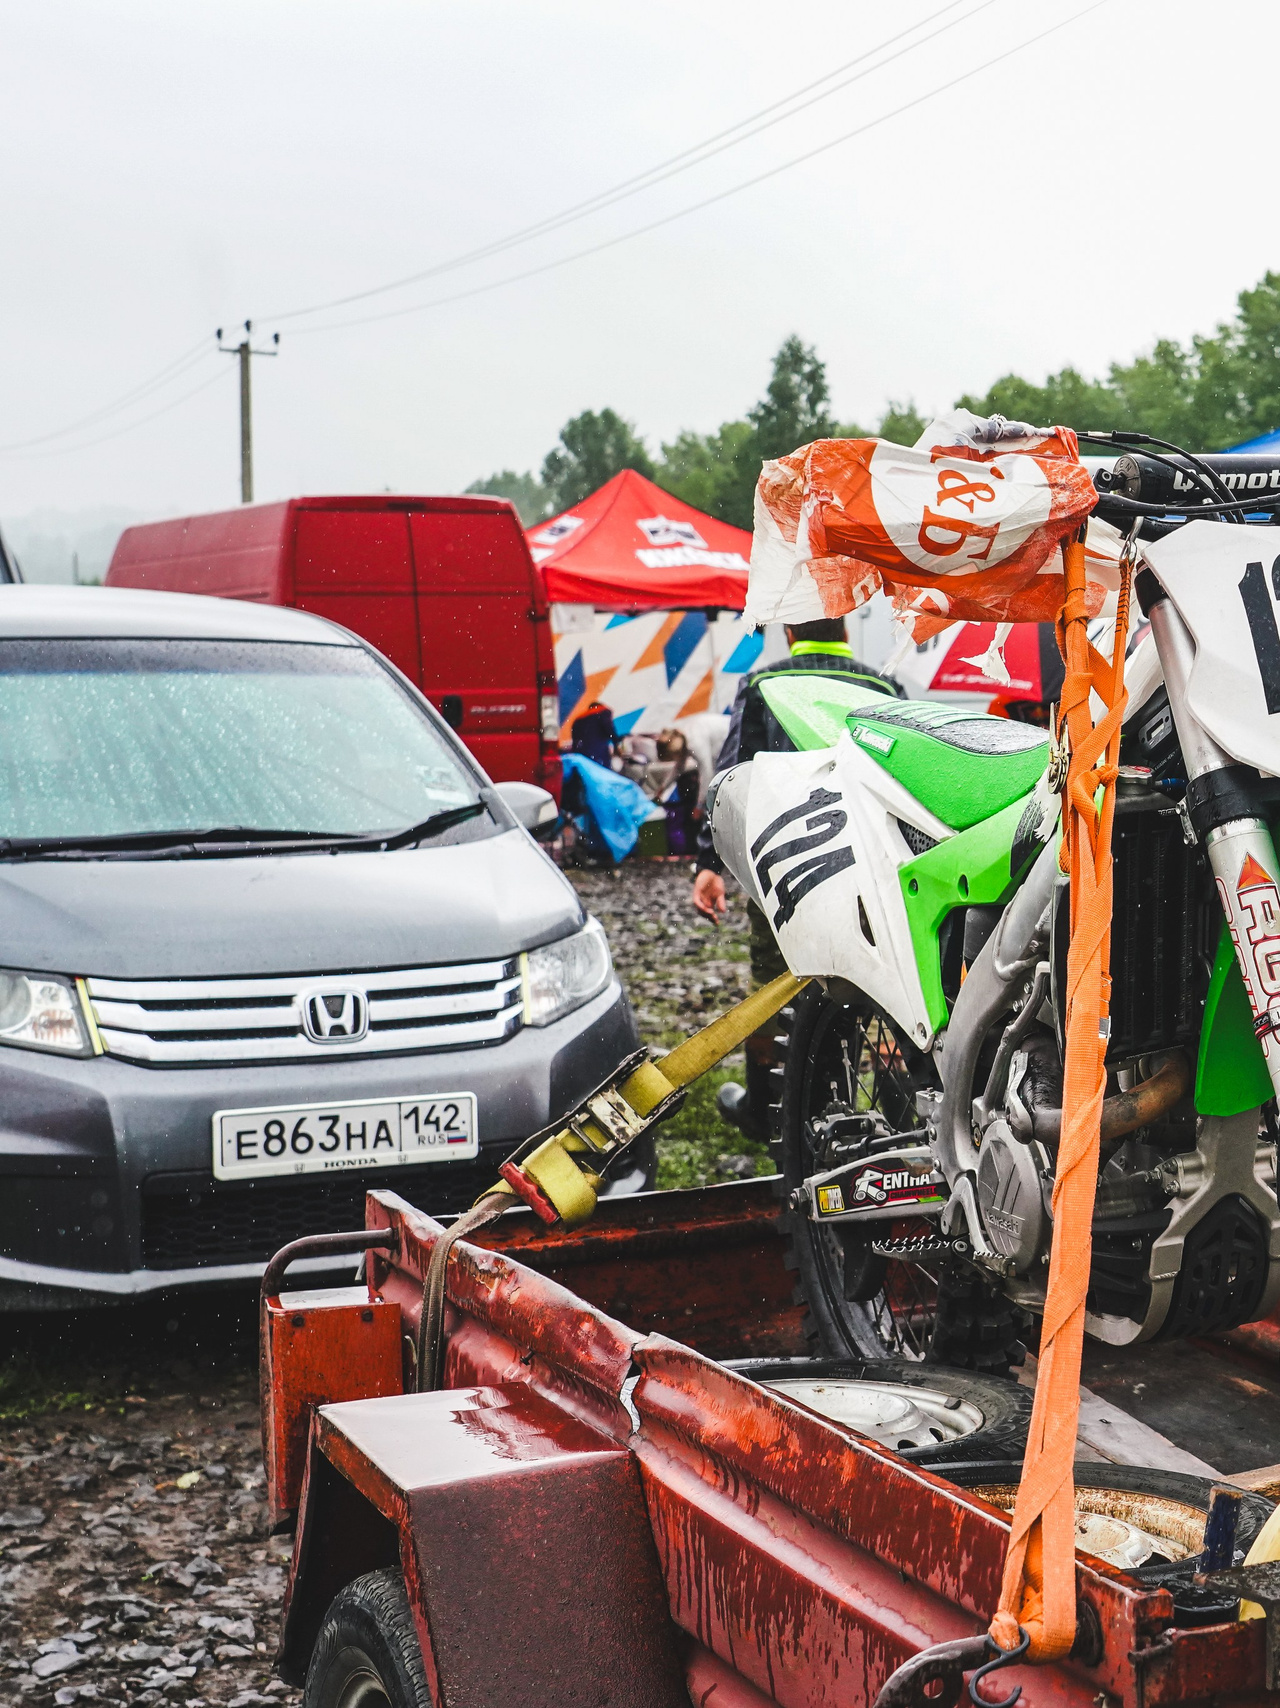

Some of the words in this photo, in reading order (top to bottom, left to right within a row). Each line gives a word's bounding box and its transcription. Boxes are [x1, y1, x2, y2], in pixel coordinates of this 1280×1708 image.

[751, 787, 857, 933] 124
[404, 1103, 460, 1134] 142
[417, 1132, 446, 1146] RUS
[324, 1156, 378, 1169] HONDA
[985, 1208, 1020, 1235] Kawasaki
